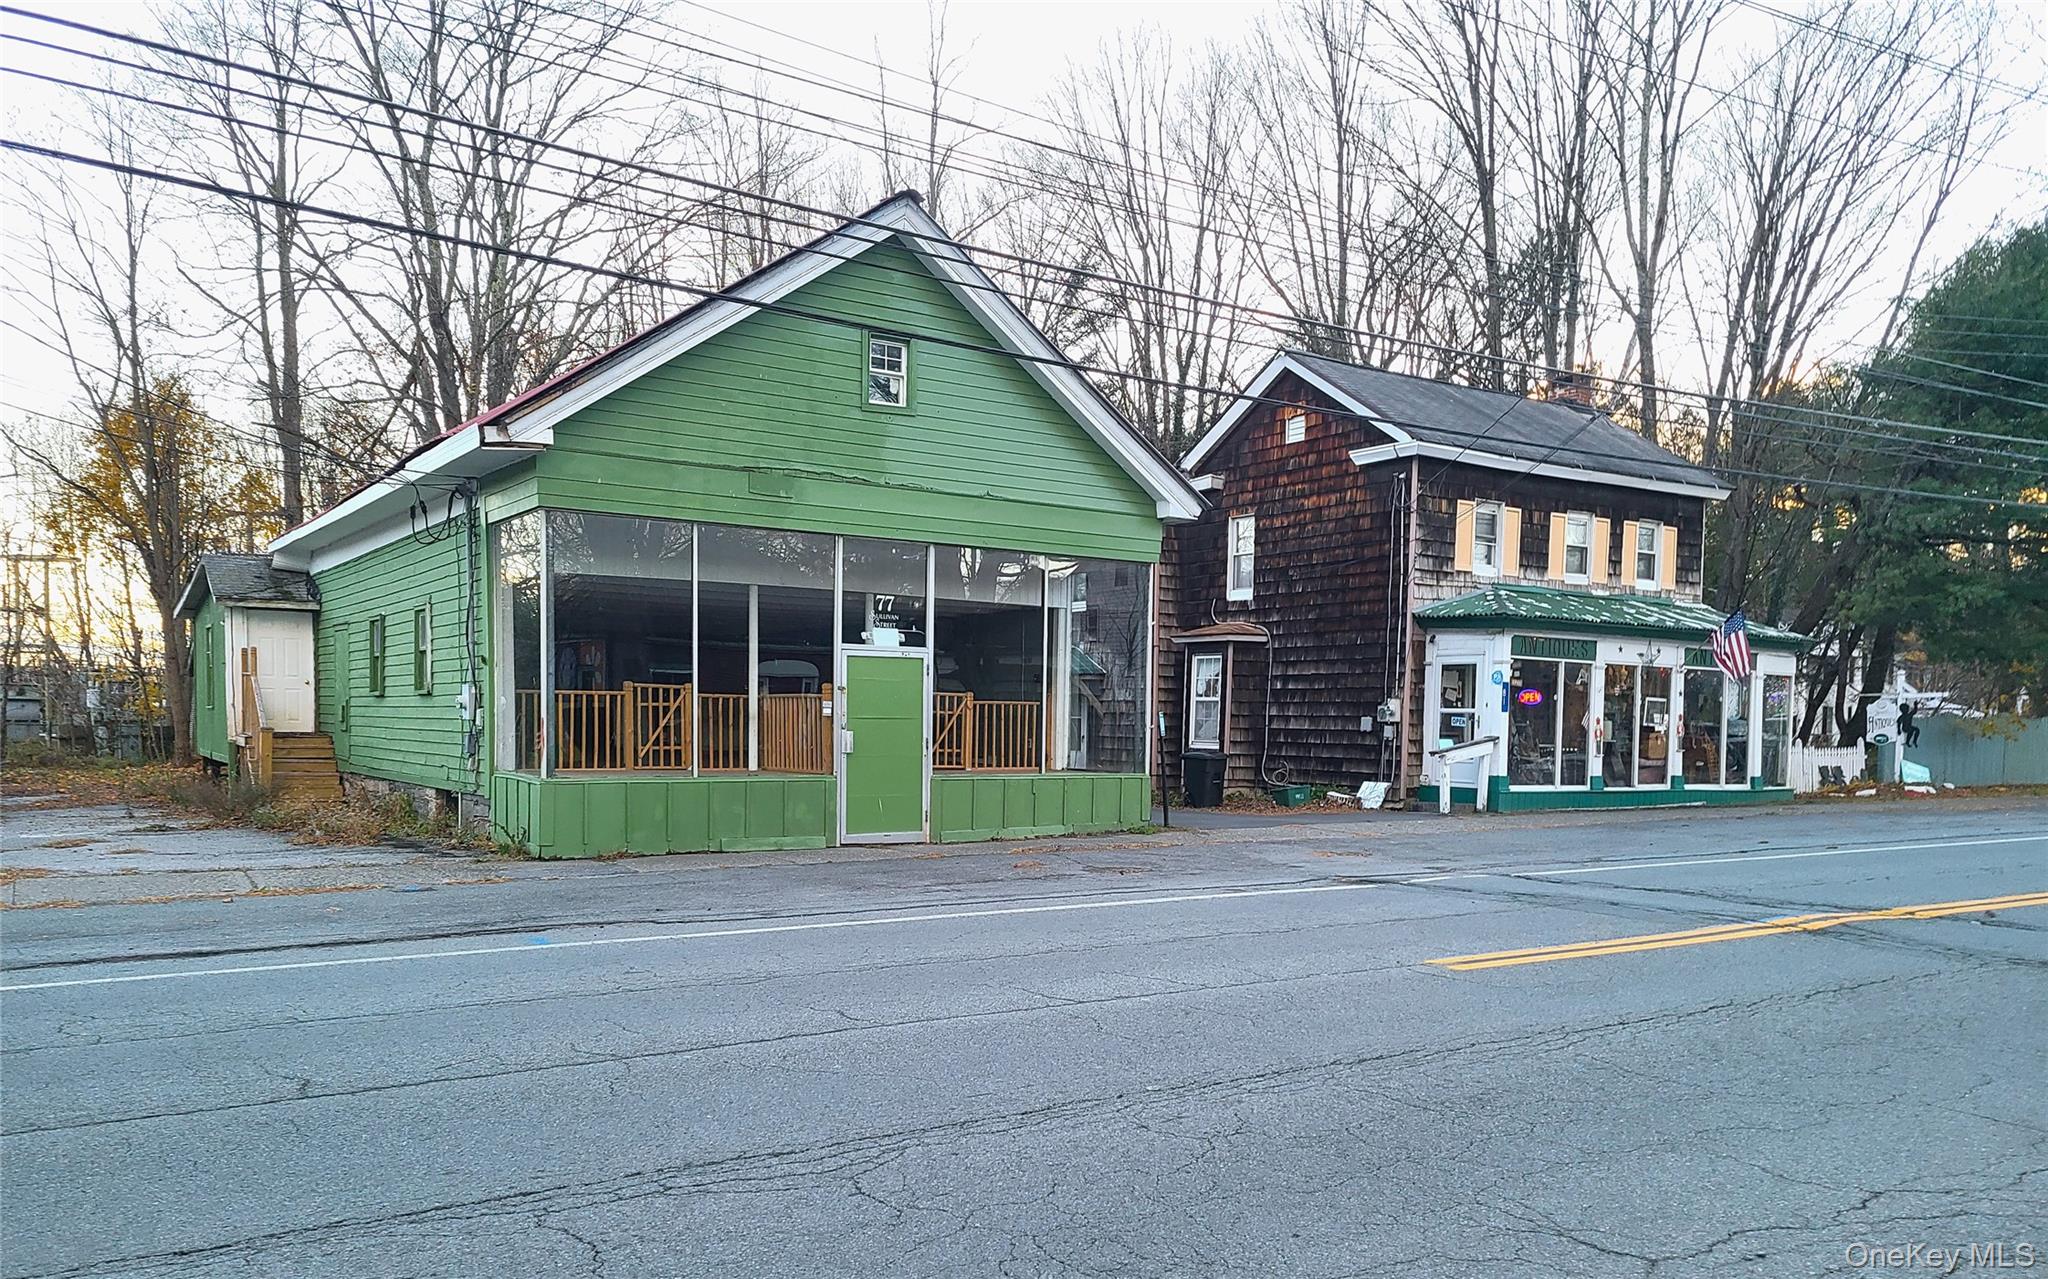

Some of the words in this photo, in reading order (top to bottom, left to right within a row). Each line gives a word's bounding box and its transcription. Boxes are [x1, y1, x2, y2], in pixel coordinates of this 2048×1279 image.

[875, 595, 895, 612] 77
[1520, 638, 1588, 657] ANTIQUES
[1520, 692, 1541, 703] OPEN
[1452, 717, 1466, 726] OPEN
